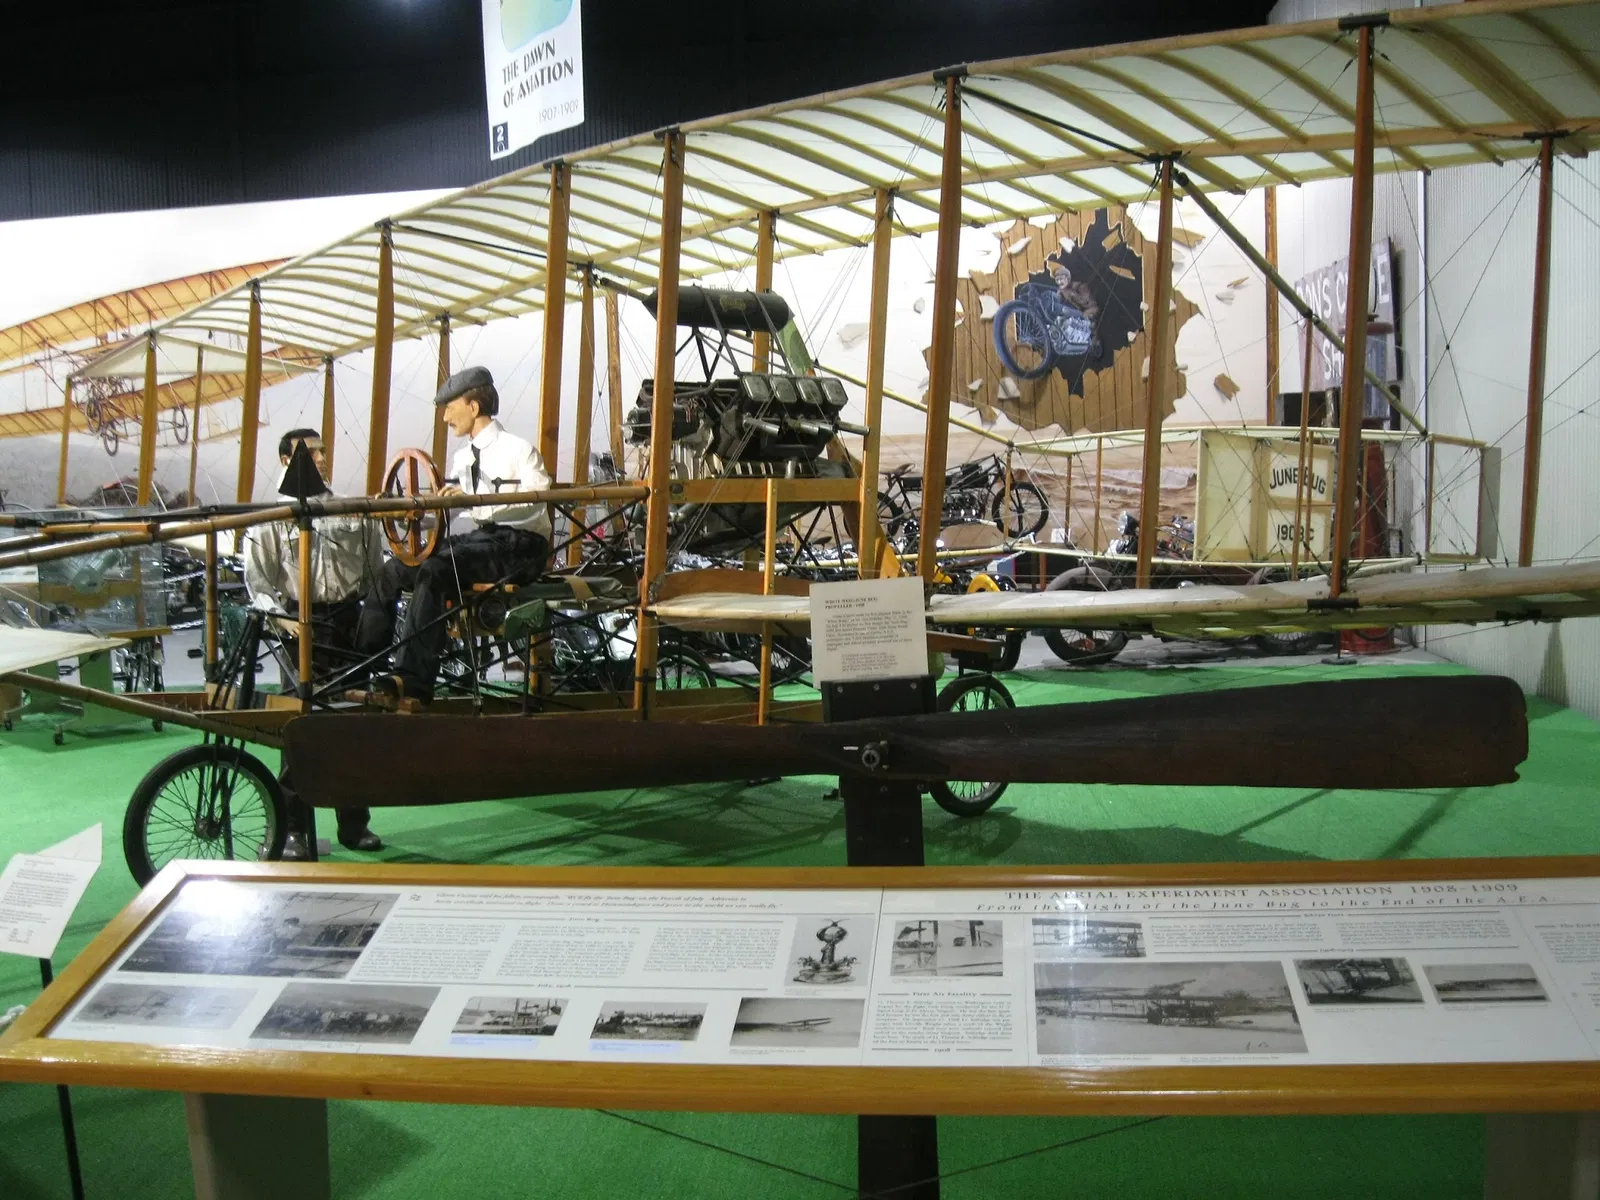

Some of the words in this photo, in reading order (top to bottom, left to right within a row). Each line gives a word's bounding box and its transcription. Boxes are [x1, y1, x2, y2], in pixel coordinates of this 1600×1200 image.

[502, 59, 519, 85] THE
[523, 37, 556, 73] DAWN
[503, 86, 515, 108] OF
[516, 55, 574, 101] AVIATION
[1269, 466, 1299, 489] JUNE
[1303, 466, 1327, 494] BUG
[977, 903, 1021, 911] From
[1211, 901, 1254, 909] June
[1265, 900, 1300, 909] Bug
[1381, 897, 1414, 906] End
[1426, 897, 1445, 905] of
[1456, 896, 1485, 904] the
[1004, 891, 1042, 899] THE
[1050, 891, 1118, 899] AERIAL
[1126, 889, 1249, 898] EXPERIMENT
[1258, 886, 1393, 897] ASSOCIATION
